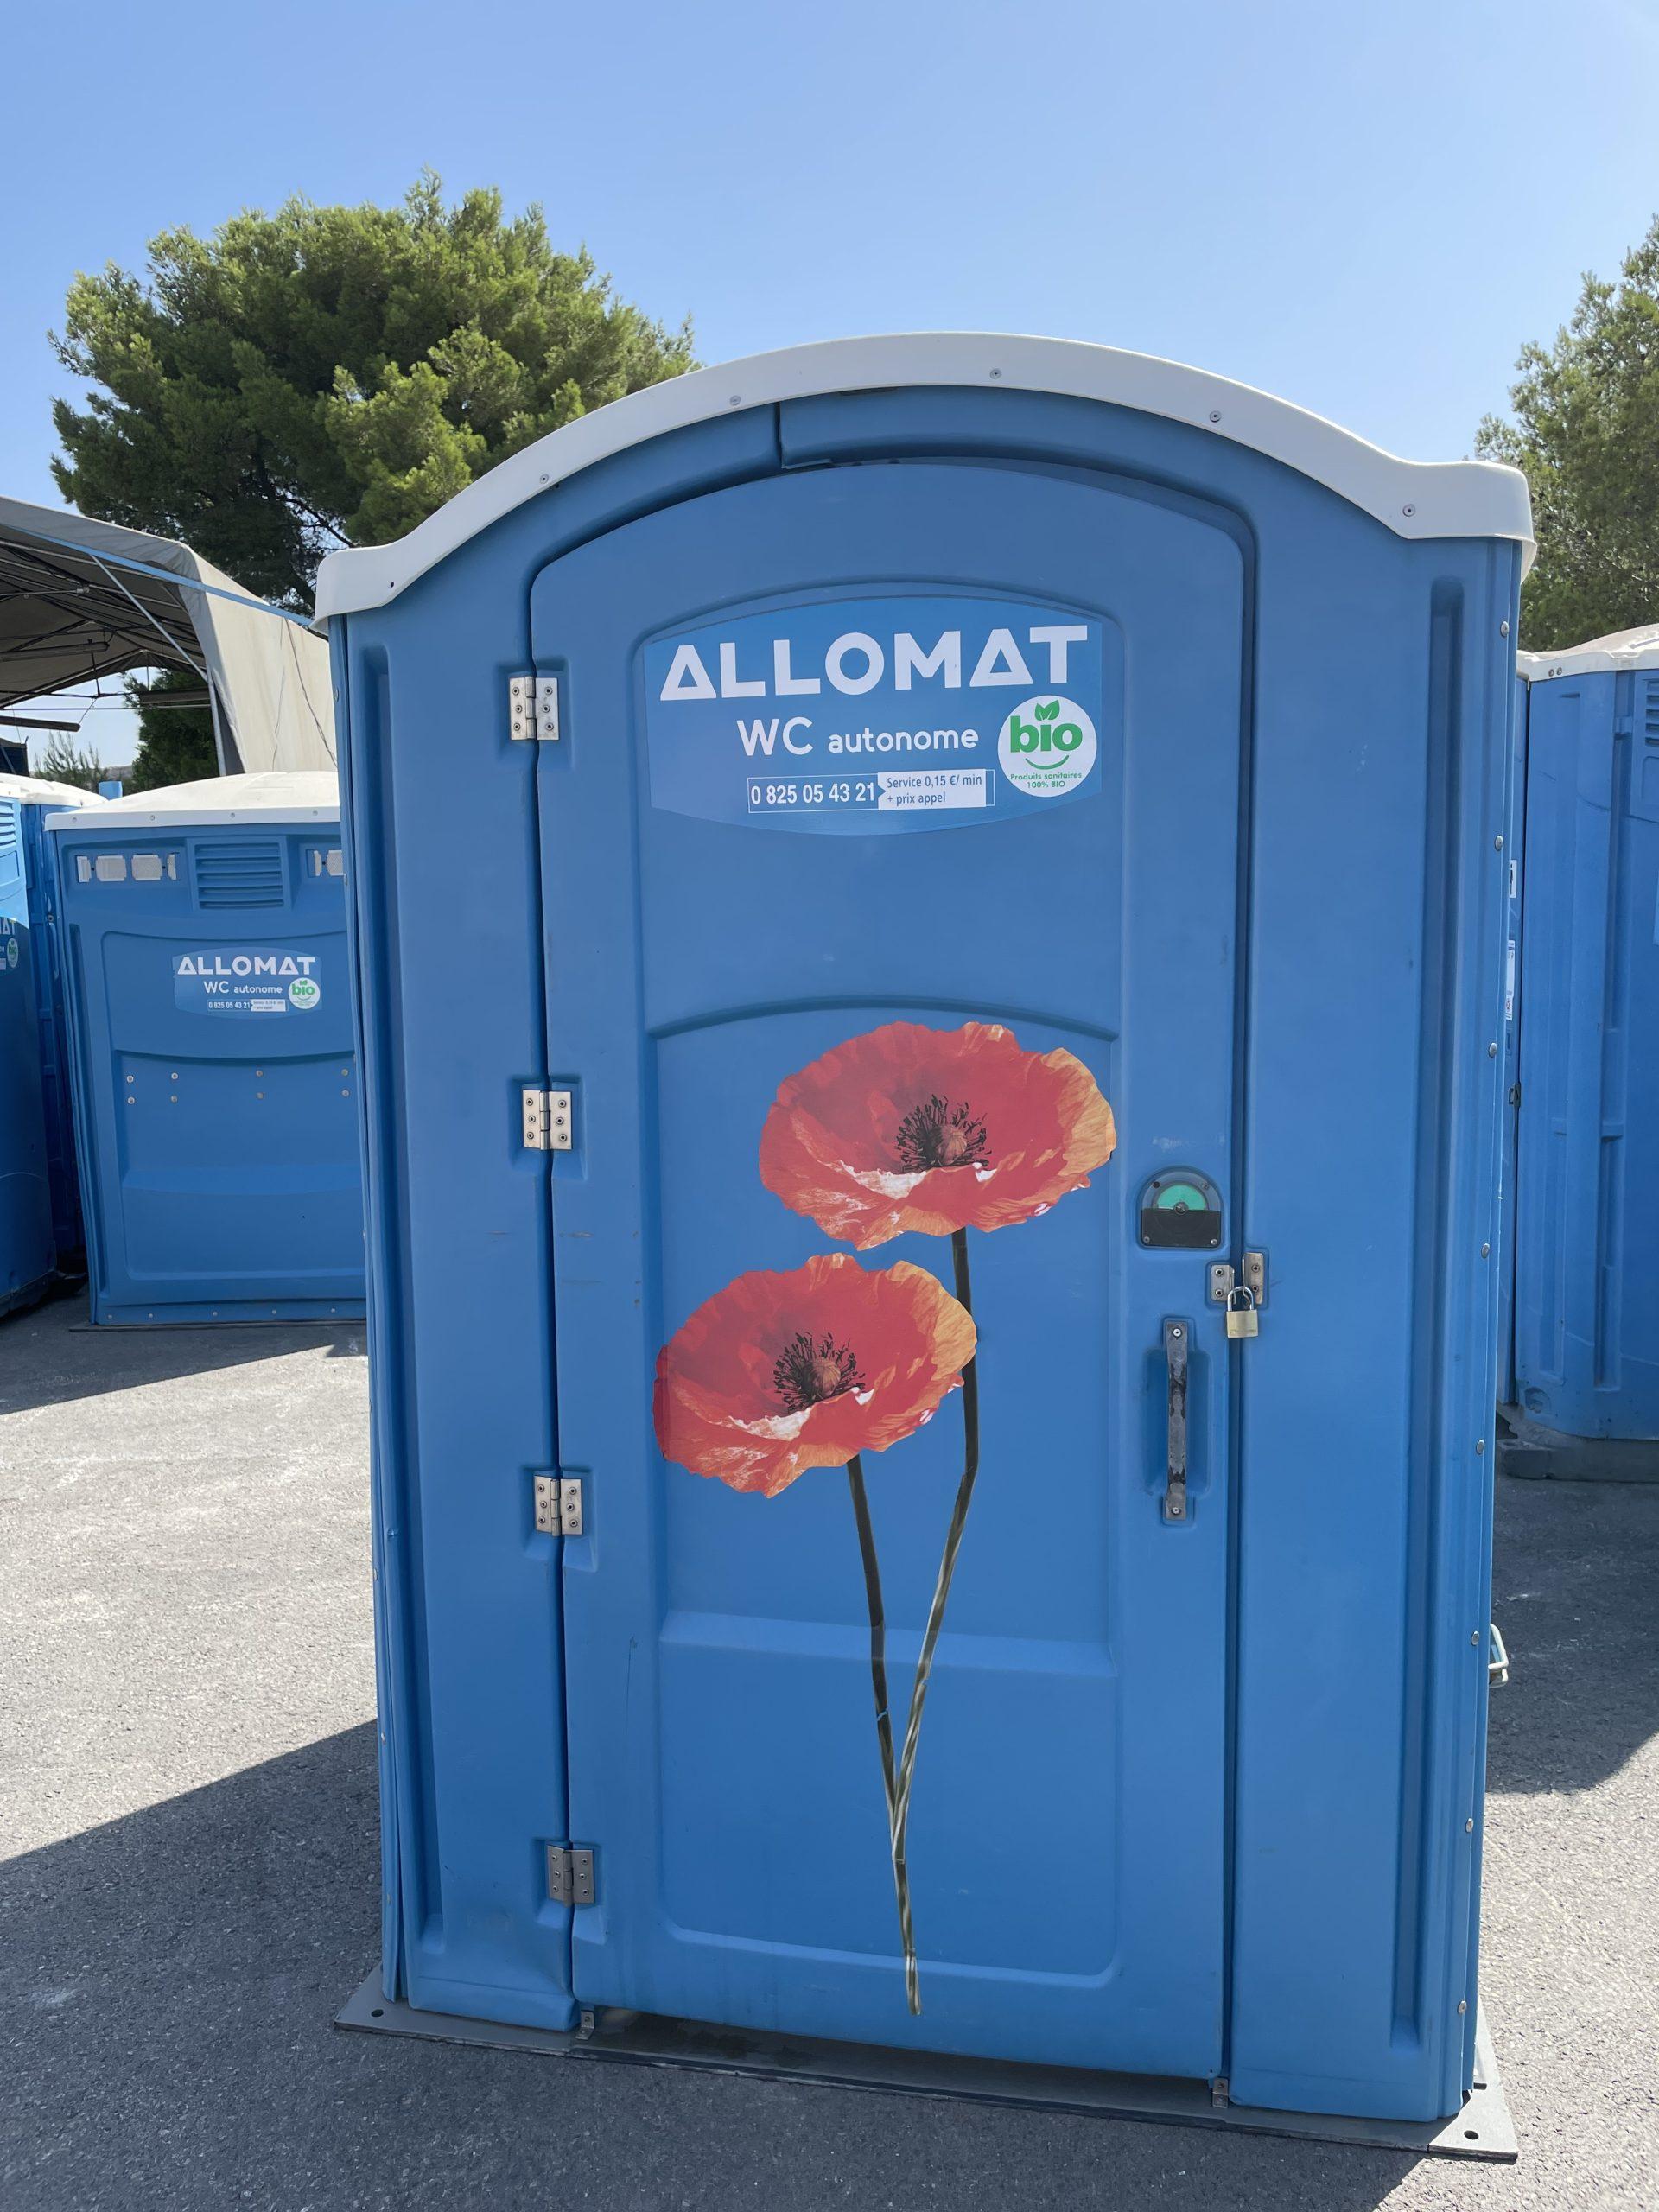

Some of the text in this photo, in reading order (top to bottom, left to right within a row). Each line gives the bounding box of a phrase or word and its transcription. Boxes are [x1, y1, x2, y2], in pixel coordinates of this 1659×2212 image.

[660, 625, 1088, 701] ALLOMAT
[736, 716, 979, 756] WC autonome
[1009, 715, 1083, 753] bio
[887, 776, 922, 788] Service
[924, 775, 946, 788] 0,15
[1010, 771, 1083, 780] Produits sanitaires
[750, 781, 875, 804] 0 825 05 43 21
[895, 793, 915, 807] prix
[918, 792, 946, 806] appel
[177, 955, 316, 976] ALLOMAT
[203, 981, 229, 994] WC
[292, 983, 315, 995] bio
